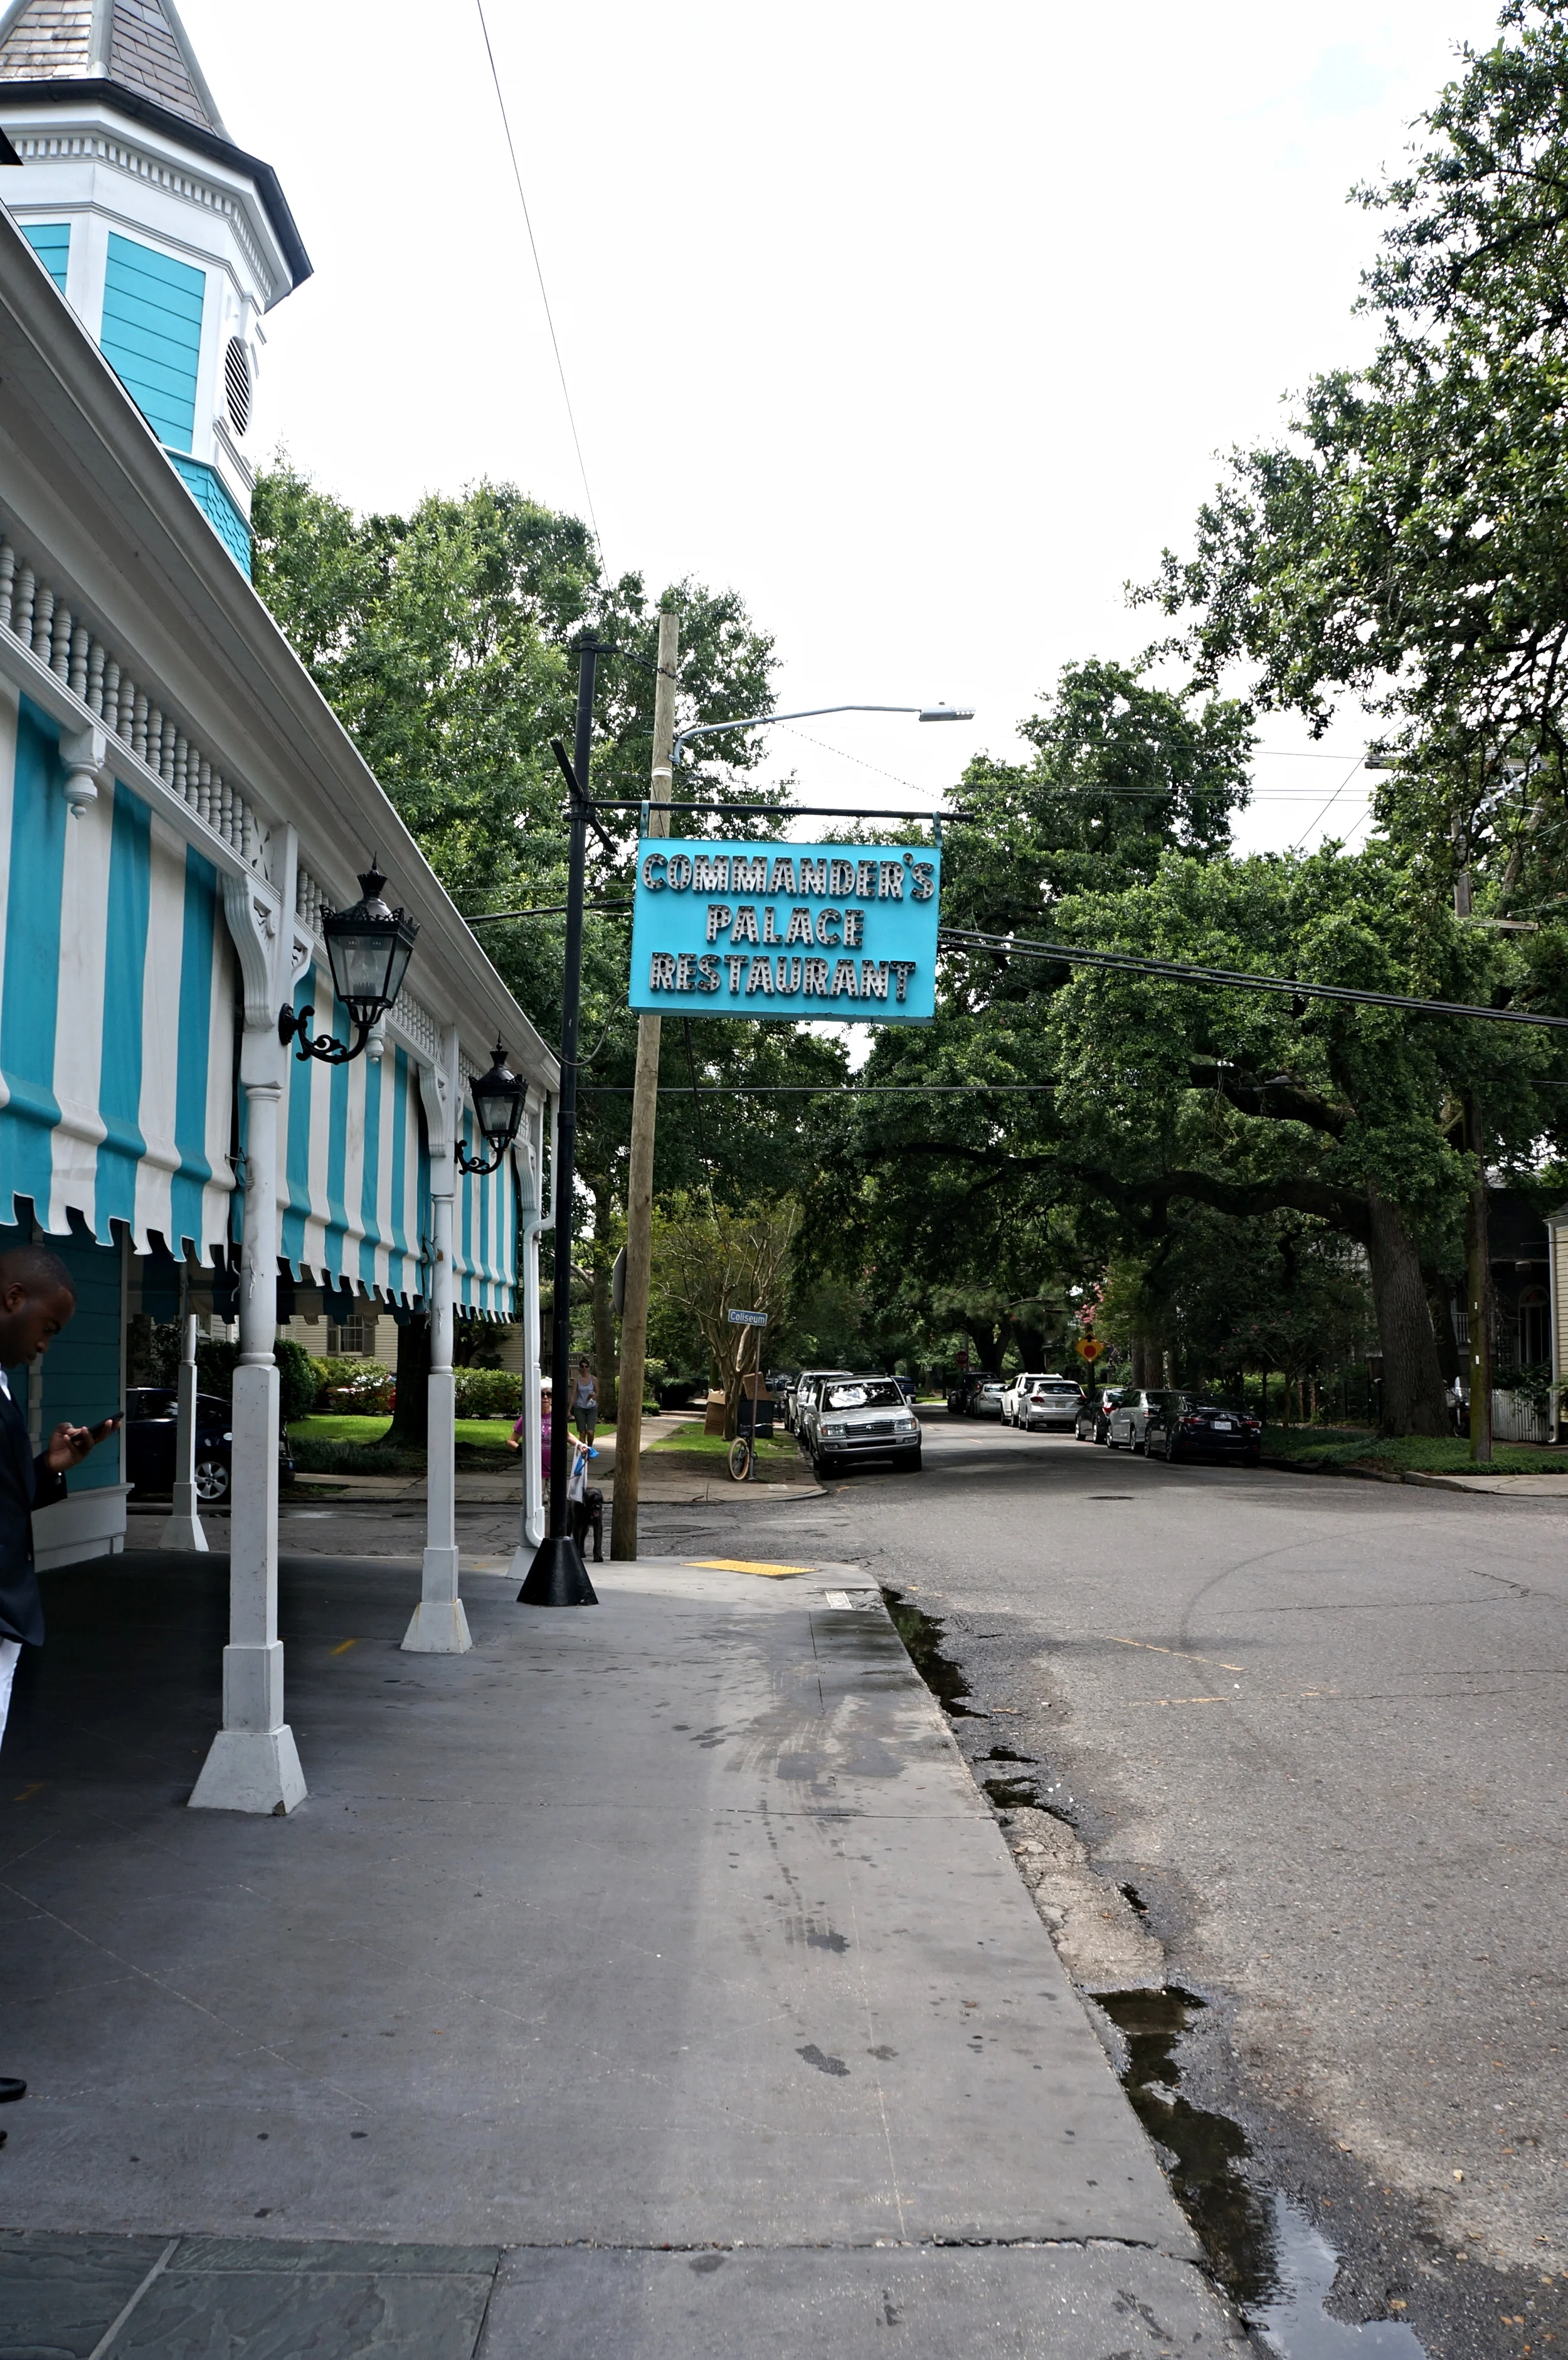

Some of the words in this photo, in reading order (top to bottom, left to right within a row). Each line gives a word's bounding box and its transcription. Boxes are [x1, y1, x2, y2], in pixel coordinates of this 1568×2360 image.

[641, 852, 935, 900] COMMANDER'S
[706, 904, 865, 949] PALACE
[649, 952, 916, 1002] RESTAURANT
[731, 1312, 765, 1324] Coliseum
